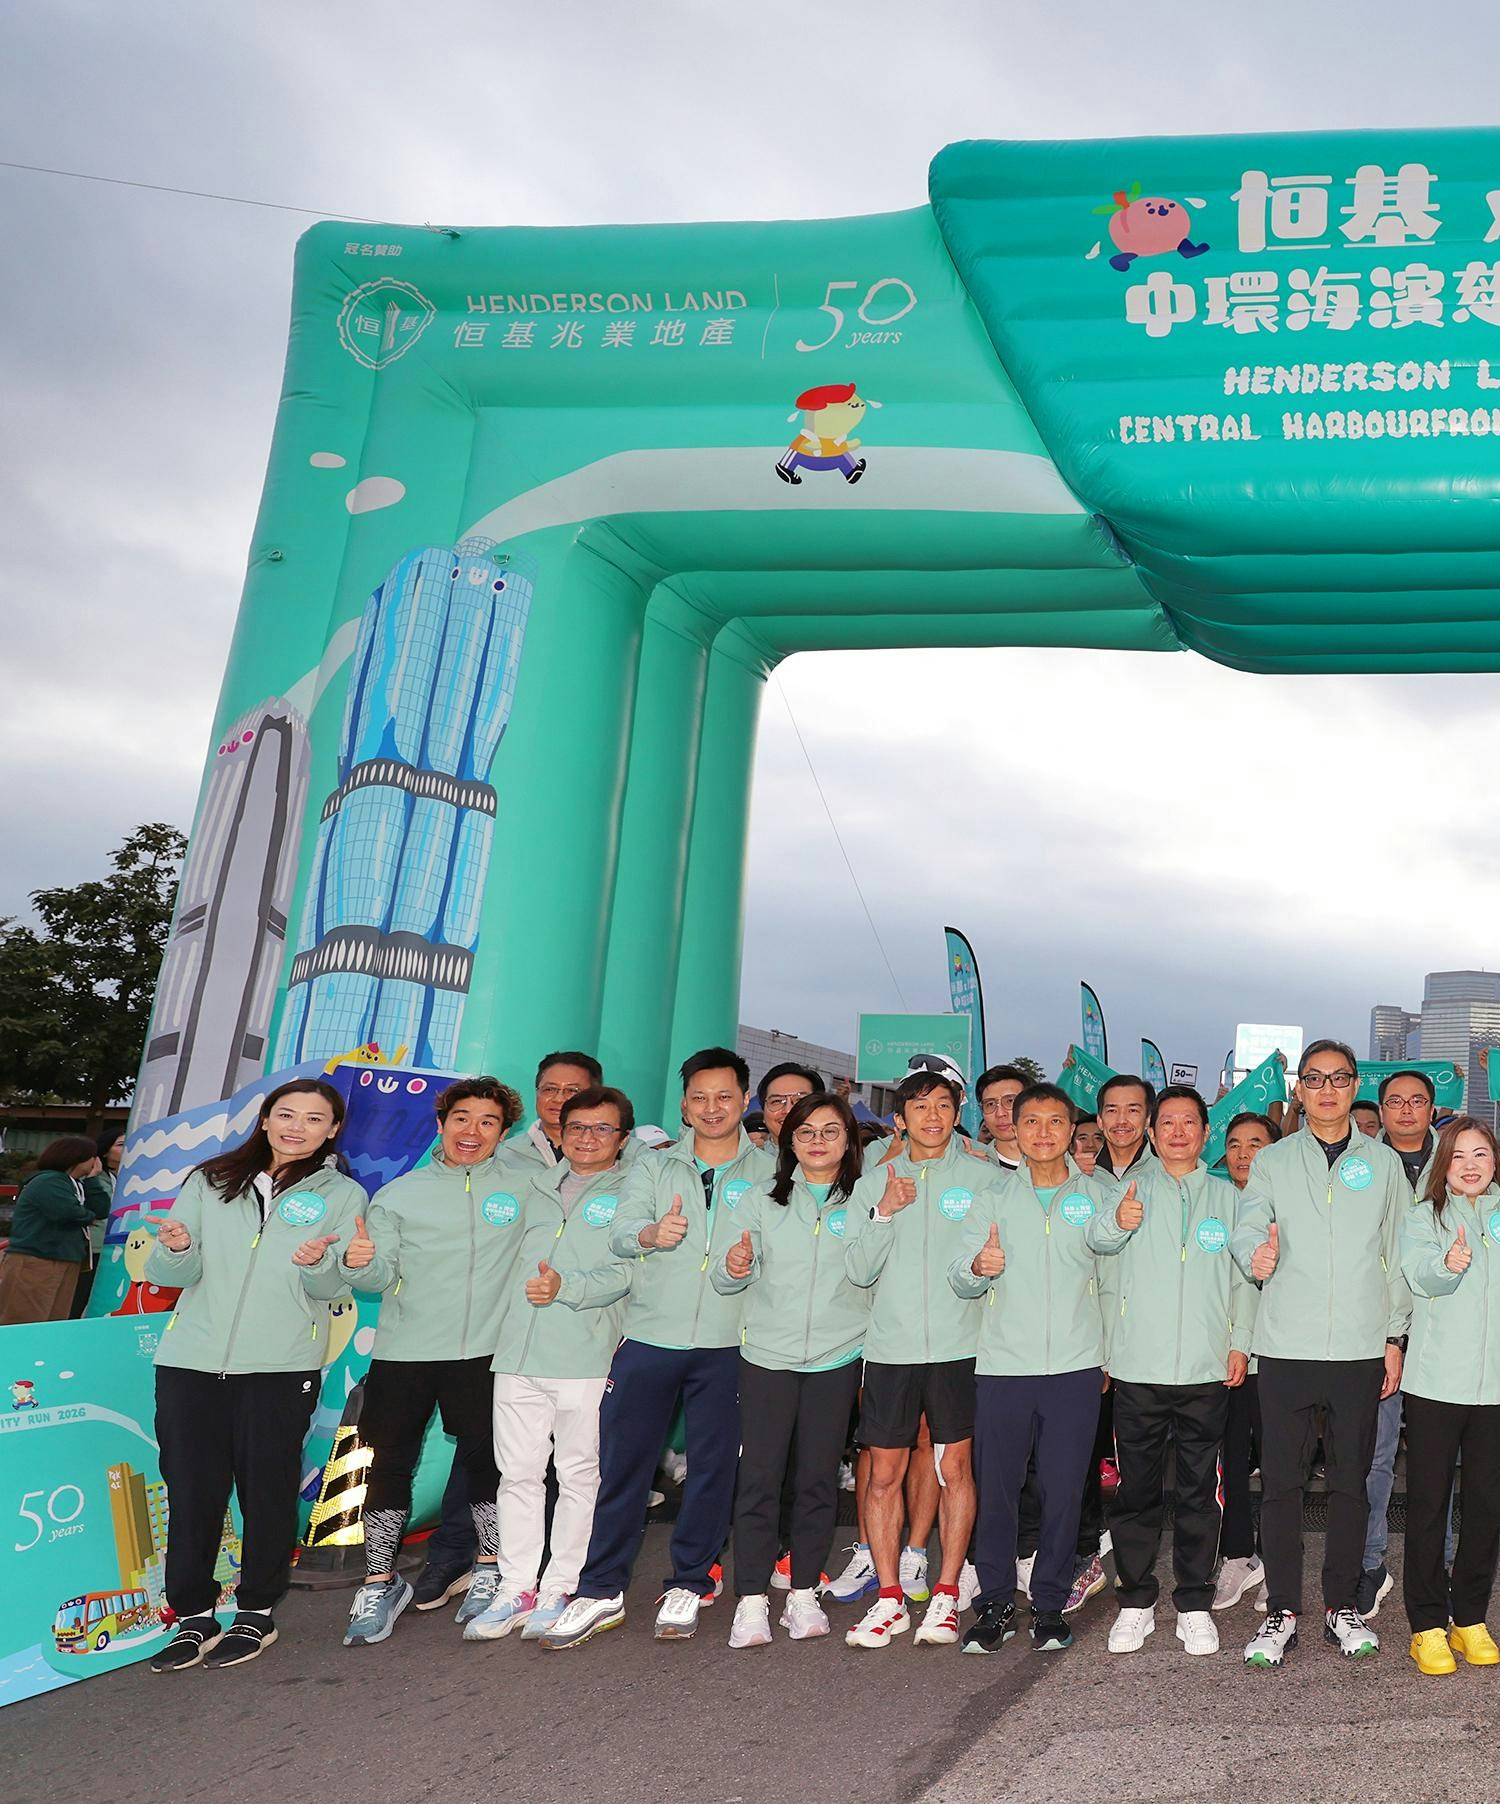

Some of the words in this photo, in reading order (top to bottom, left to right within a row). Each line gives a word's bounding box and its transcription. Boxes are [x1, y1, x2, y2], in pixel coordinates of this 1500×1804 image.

[1230, 163, 1442, 253] 恒基
[467, 292, 653, 314] HENDERSON
[664, 290, 748, 312] LAND
[795, 277, 918, 352] 50
[453, 318, 737, 349] 恒基兆業地產
[844, 331, 903, 349] years
[1223, 359, 1451, 395] HENDERSON
[1118, 413, 1262, 444] CENTRAL
[28, 1412, 51, 1425] RUN
[57, 1407, 87, 1421] 2026
[15, 1484, 85, 1552] 50
[48, 1523, 85, 1543] years
